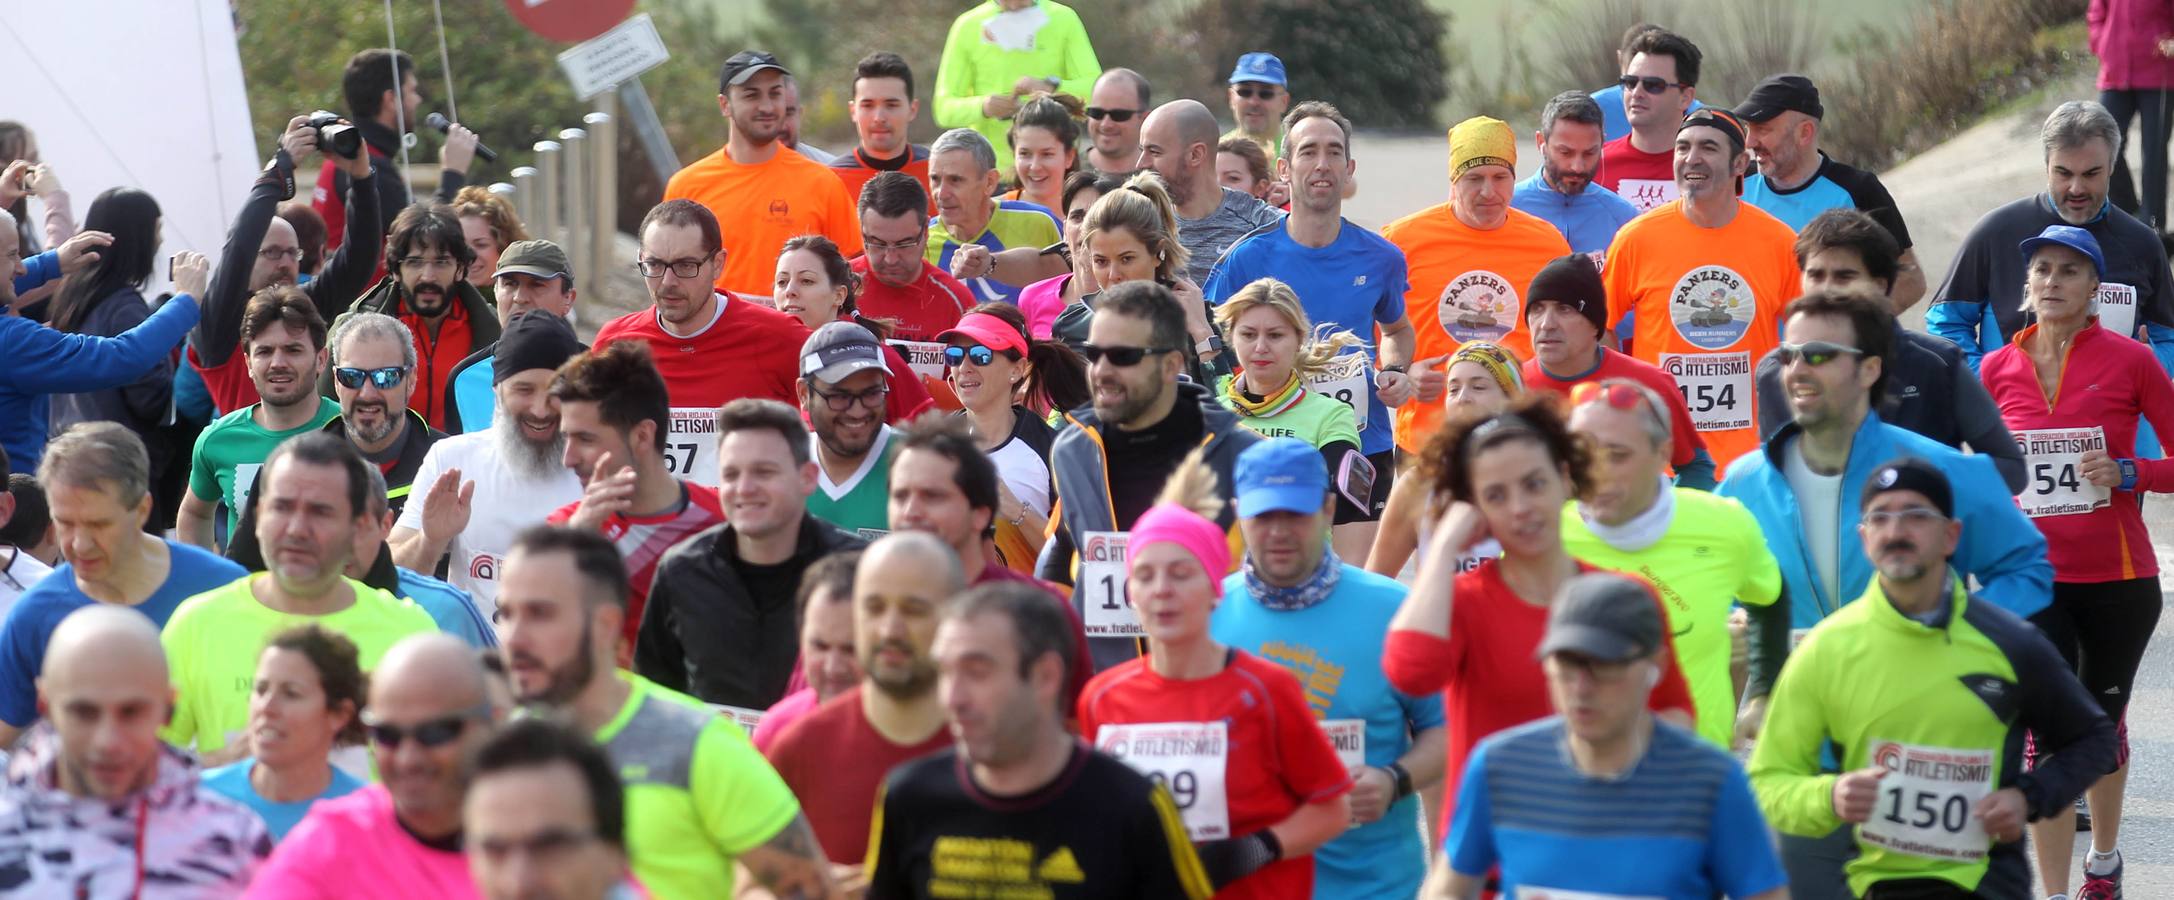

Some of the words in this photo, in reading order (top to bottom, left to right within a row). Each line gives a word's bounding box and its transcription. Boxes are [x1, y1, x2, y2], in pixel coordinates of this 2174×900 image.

[1445, 276, 1506, 307] PANZERS
[1676, 271, 1739, 305] PANZERS
[1686, 361, 1749, 376] ATLETISMO
[1318, 388, 1355, 410] 8
[669, 419, 716, 434] LETISM
[1696, 420, 1750, 430] tletismo.com
[2031, 437, 2103, 455] ATLETISMO
[2035, 464, 2081, 495] 54
[1101, 575, 1130, 609] 1
[1884, 787, 1968, 833] 150
